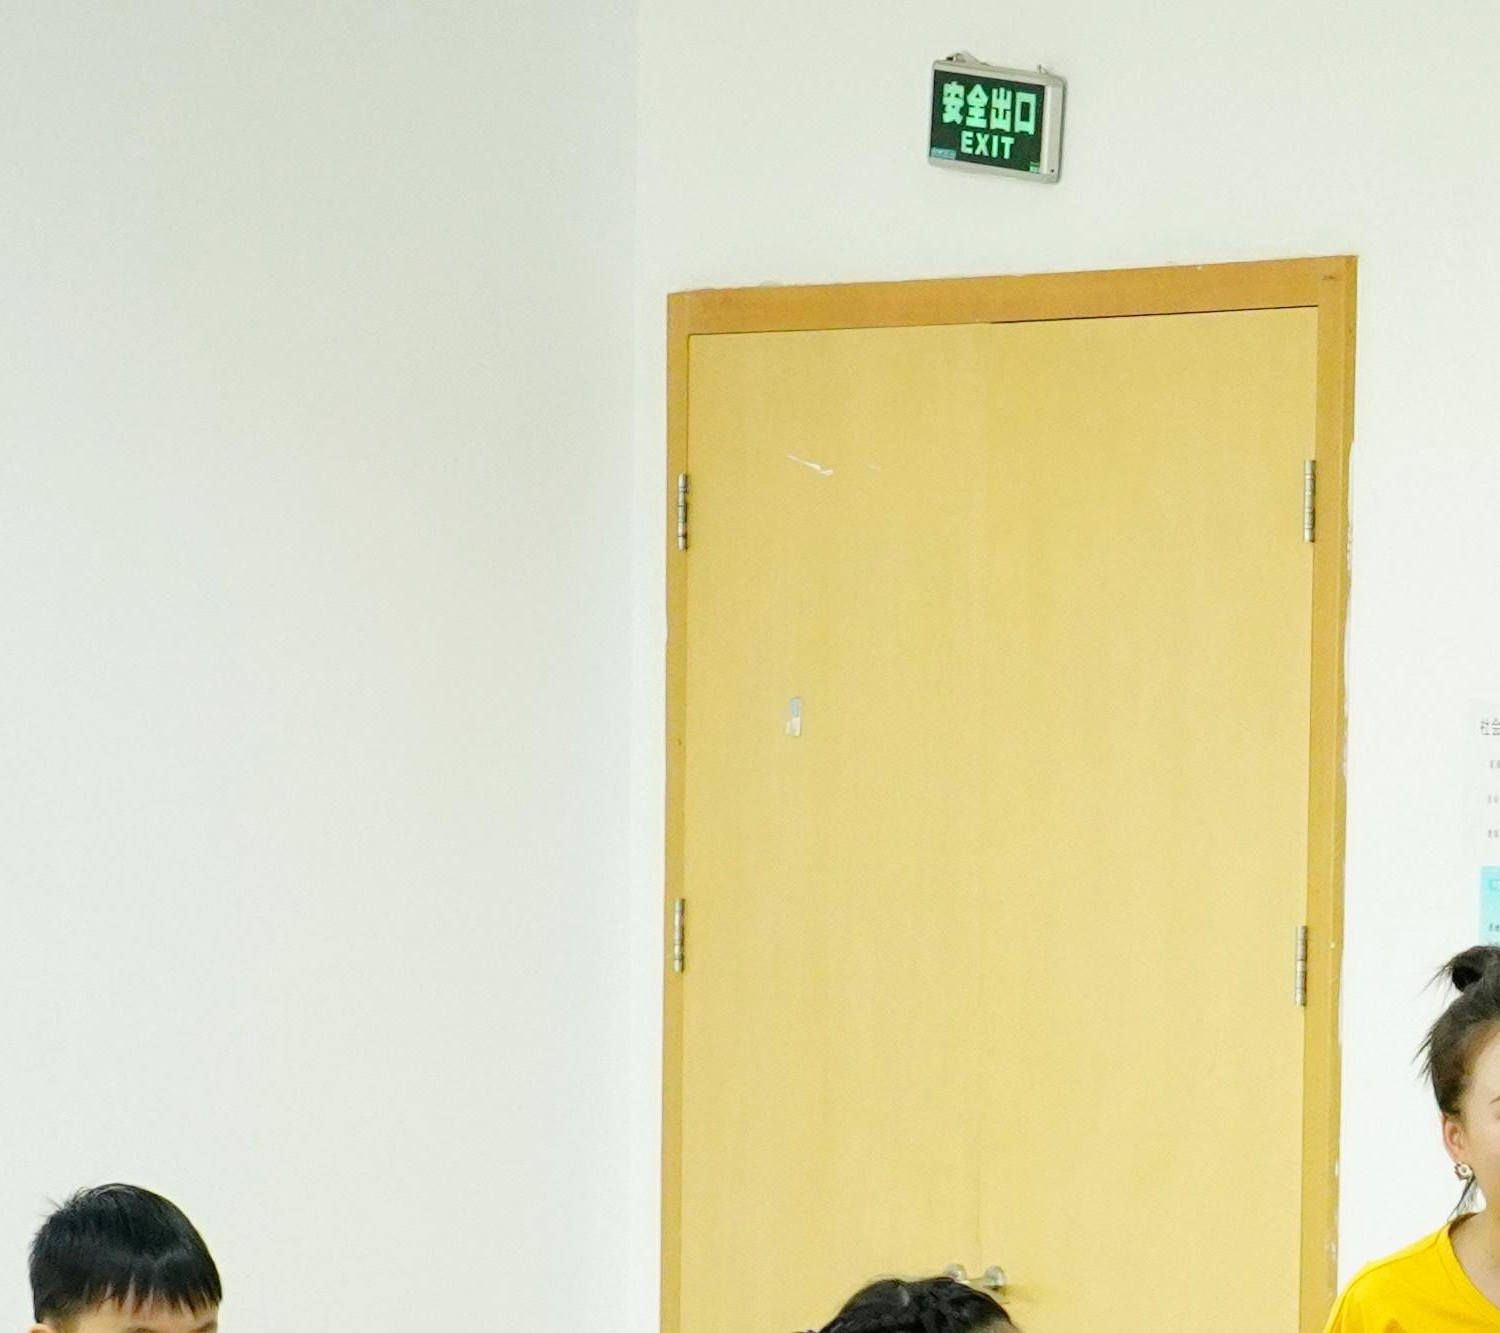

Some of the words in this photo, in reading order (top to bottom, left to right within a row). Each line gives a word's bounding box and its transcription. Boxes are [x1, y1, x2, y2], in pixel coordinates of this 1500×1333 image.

[942, 80, 1037, 135] 安全出口
[960, 130, 1015, 160] EXIT
